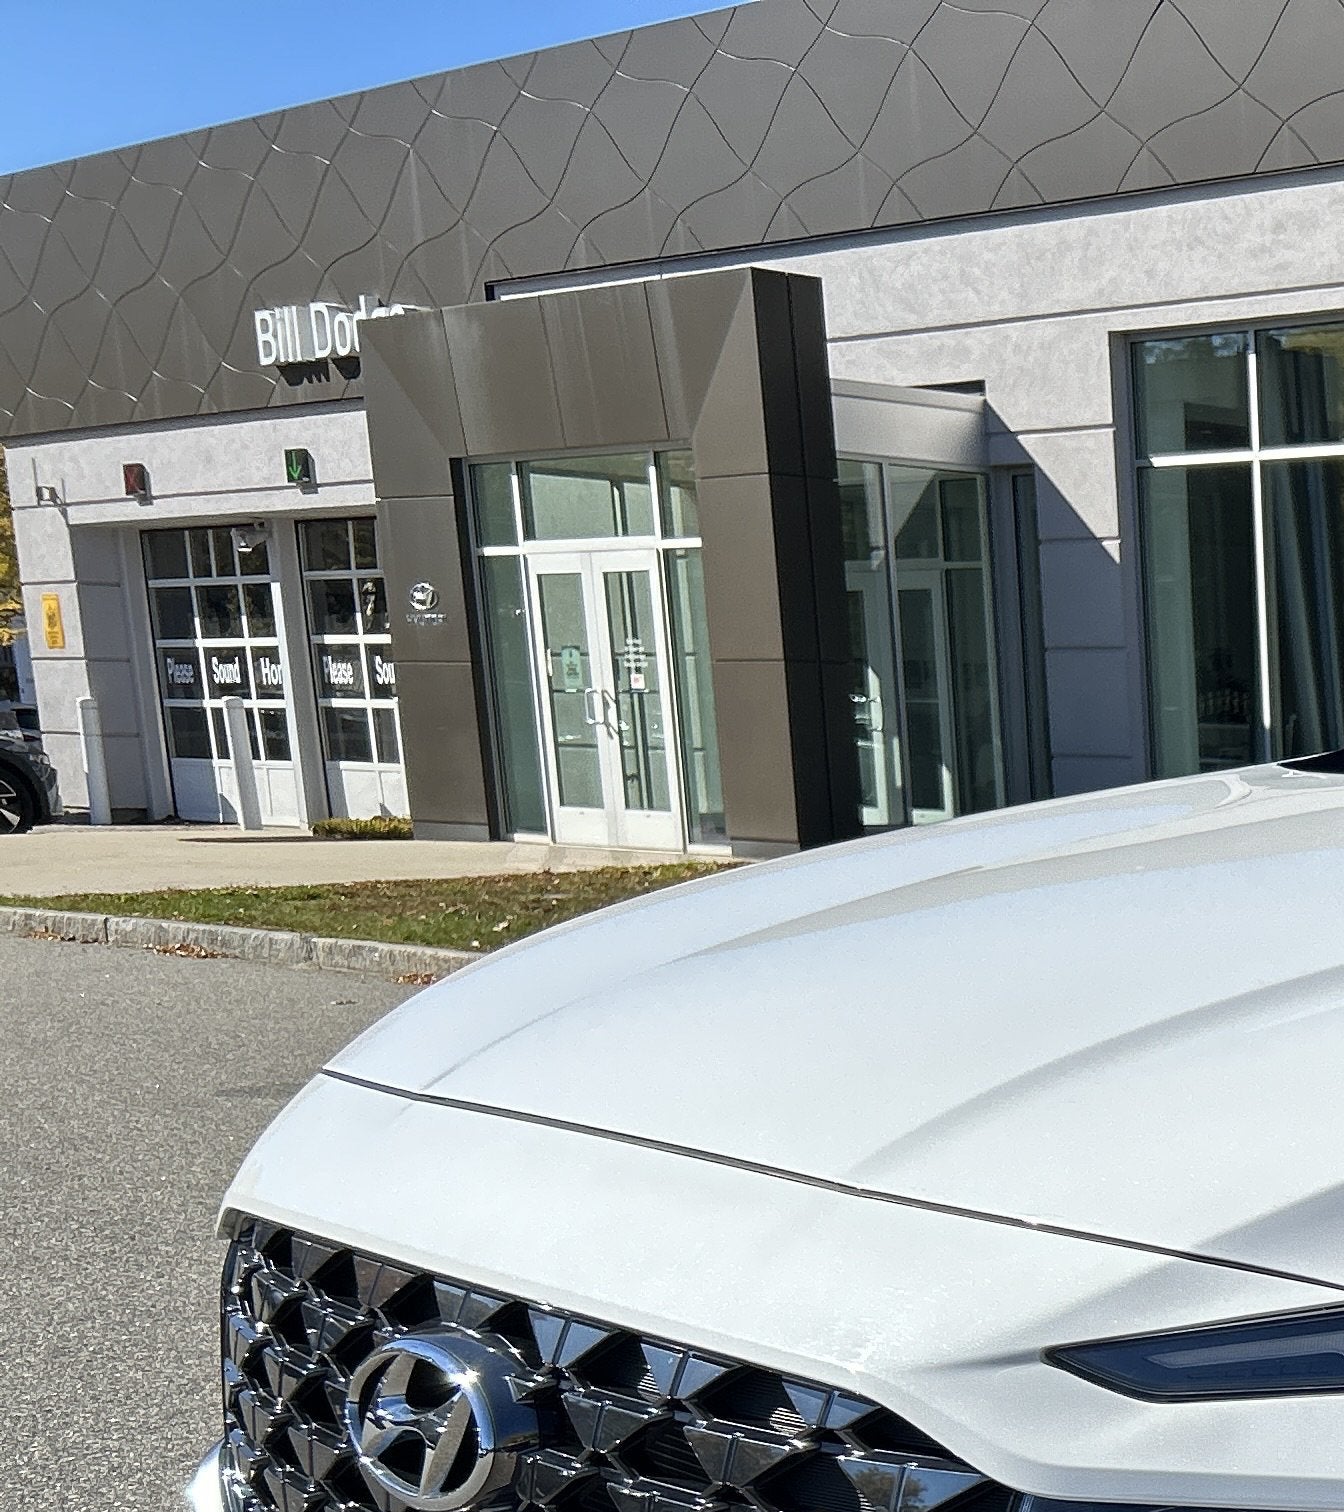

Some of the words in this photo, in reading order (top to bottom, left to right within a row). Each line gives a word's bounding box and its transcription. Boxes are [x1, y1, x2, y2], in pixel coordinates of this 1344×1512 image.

[254, 305, 303, 366] Bill
[309, 295, 405, 359] Dod
[211, 656, 241, 685] Sound
[259, 656, 283, 686] Hor
[322, 655, 354, 685] Please
[374, 655, 396, 685] Sou
